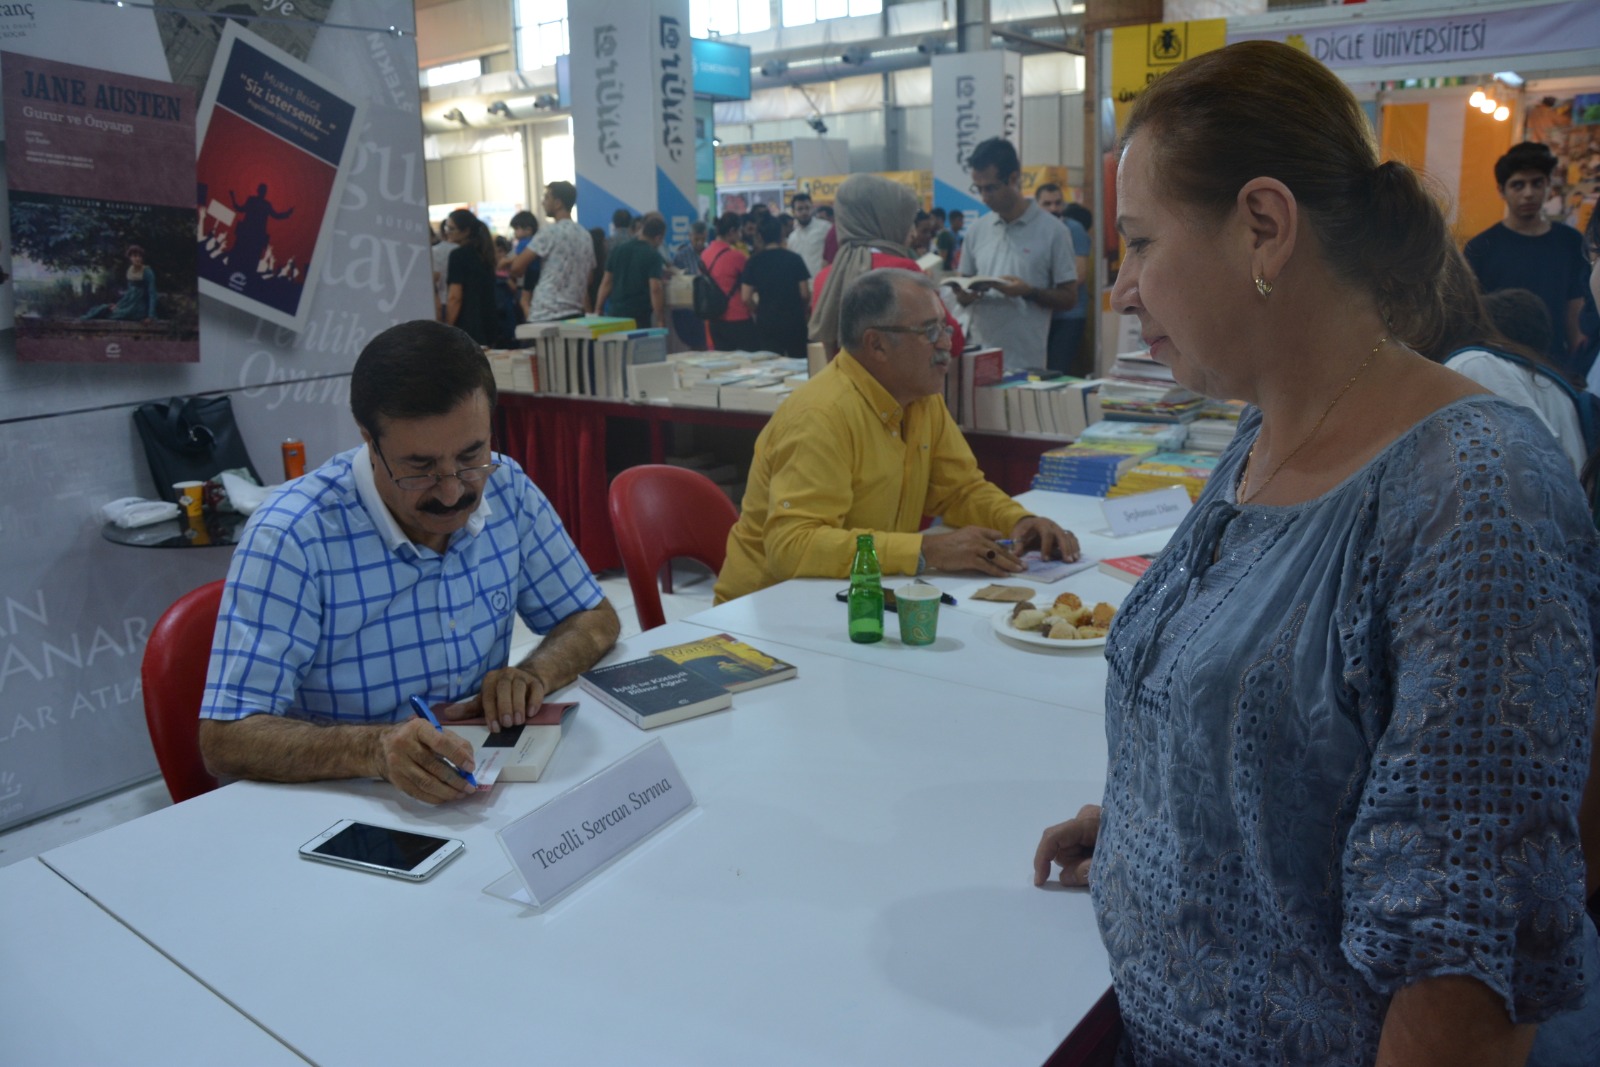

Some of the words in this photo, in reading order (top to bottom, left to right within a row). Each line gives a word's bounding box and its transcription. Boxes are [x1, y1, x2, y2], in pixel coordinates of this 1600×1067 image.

[1315, 32, 1365, 61] DİCLE
[1373, 18, 1487, 58] ÜNİVERSİTESİ
[21, 70, 86, 106] JANE
[95, 84, 181, 121] AUSTEN
[22, 105, 65, 124] Gurur
[66, 114, 82, 126] ve
[84, 113, 135, 134] Önyargı
[321, 229, 433, 314] tay
[532, 828, 585, 870] Tecelli
[581, 803, 632, 841] Sercan
[628, 778, 673, 811] Sırma
